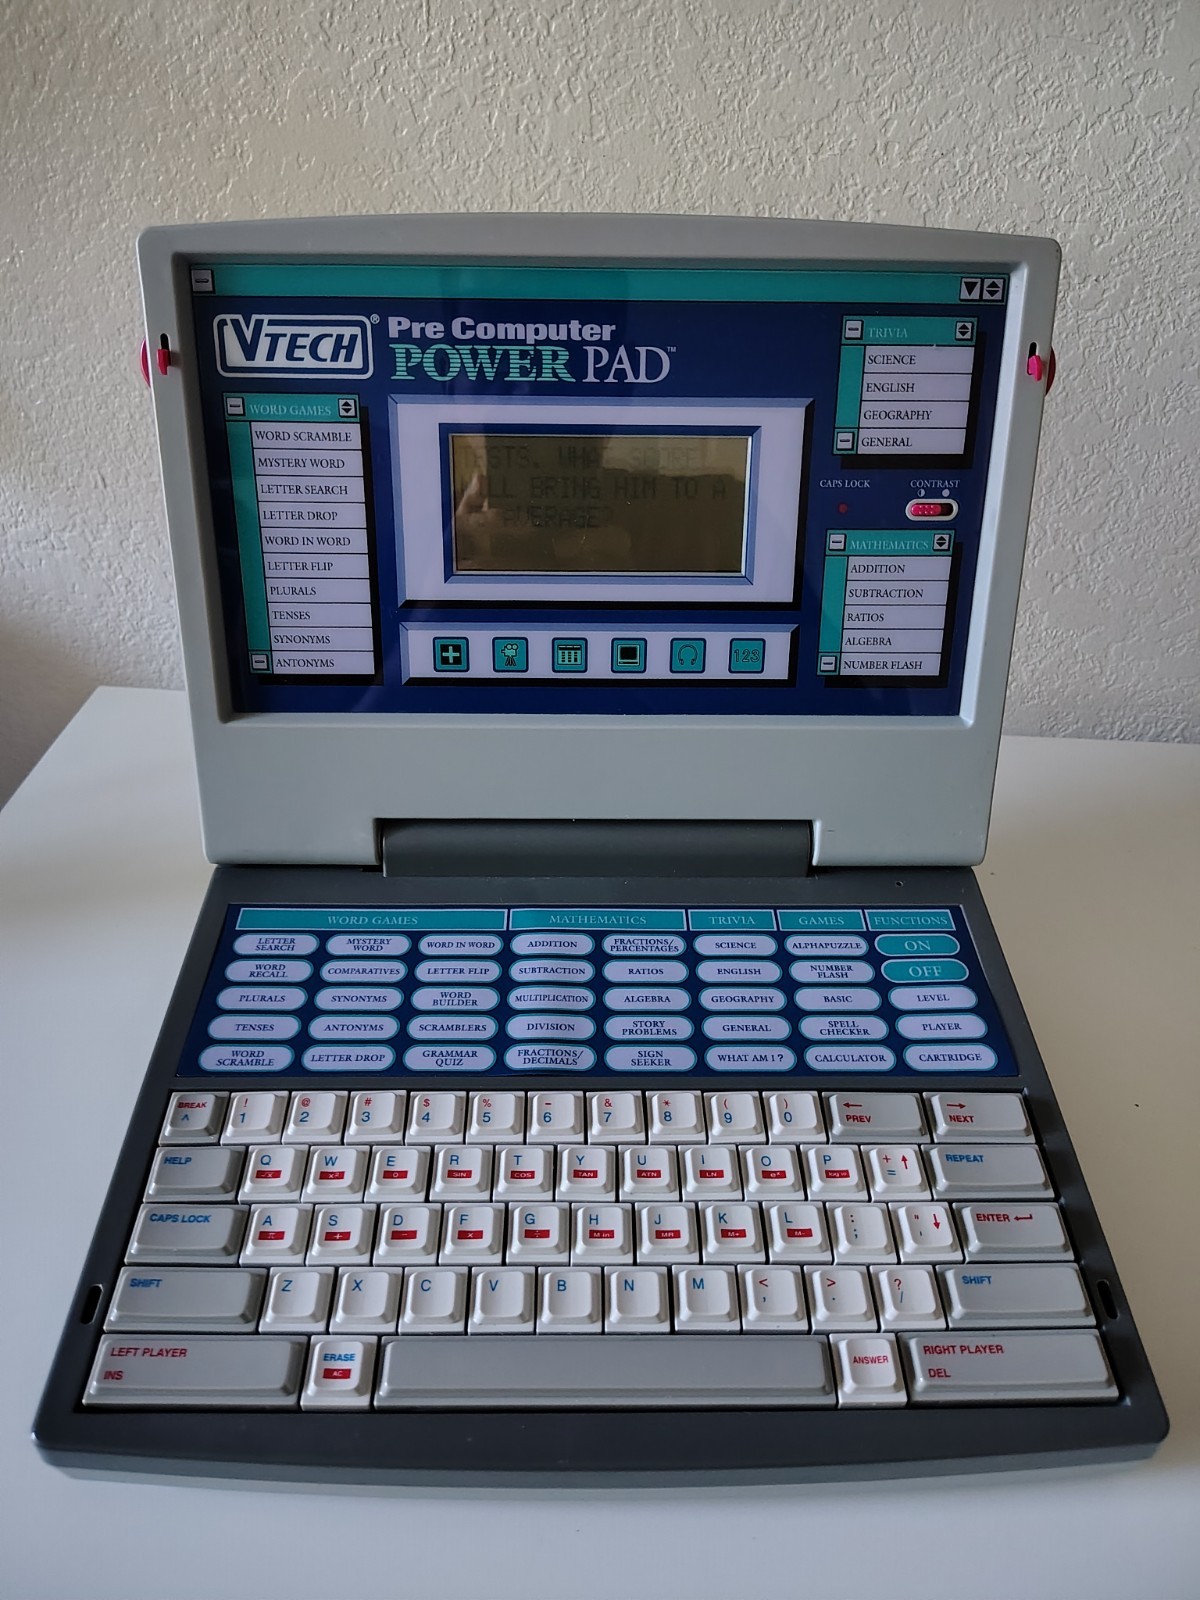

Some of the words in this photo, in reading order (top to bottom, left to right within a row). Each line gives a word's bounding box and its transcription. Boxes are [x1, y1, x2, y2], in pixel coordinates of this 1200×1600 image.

[388, 316, 445, 339] Pre
[451, 317, 616, 344] Computer
[867, 326, 909, 339] TRIVIA
[229, 317, 359, 363] VTECH
[389, 343, 577, 382] POWER
[582, 345, 671, 383] PAD
[866, 353, 918, 366] SCIENCE
[865, 381, 916, 394] ENGLISH
[248, 403, 287, 416] WORD
[290, 404, 332, 417] GAMES
[862, 409, 934, 422] GEOGRAPHY
[254, 429, 291, 442] WORD
[291, 430, 353, 443] SCRAMBLE
[860, 436, 914, 448] GENERAL
[257, 457, 308, 470] MYSTERY
[309, 457, 346, 470] WORD
[260, 483, 303, 496] LETTER
[304, 484, 349, 496] SEARCH
[818, 479, 844, 489] CAPS
[843, 479, 872, 489] LOCK
[909, 479, 961, 489] CONTRAST
[262, 509, 305, 522] LETTER
[305, 509, 338, 522] DROP
[264, 535, 300, 548] WORD
[301, 535, 315, 548] IN
[315, 535, 352, 548] WORD
[849, 539, 930, 551] MATHEMATICS
[266, 560, 309, 573] LETTER
[309, 560, 334, 573] FLIP
[849, 563, 907, 575] ADDITION
[269, 585, 317, 598] PLURALS
[847, 587, 925, 599] SUBTRACTION
[271, 609, 311, 622] TENSES
[846, 612, 886, 623] RATIOS
[273, 633, 332, 646] SYNONYMS
[844, 636, 893, 647] ALGEBRA
[733, 648, 760, 663] 123
[274, 657, 336, 670] ANTONYMS
[842, 660, 889, 671] NUMBER
[889, 660, 924, 671] FLASH
[327, 915, 370, 926] WORD
[371, 915, 419, 926] GAMES
[548, 914, 648, 926] MATHEMATICS
[707, 915, 756, 926] TRIVIA
[798, 915, 845, 926] GAMES
[873, 915, 949, 926] FUNCTIONS
[257, 937, 297, 945] LETTER
[345, 937, 393, 946] MYSTERY
[425, 940, 455, 949] WORD
[455, 940, 467, 949] IN
[467, 940, 496, 950] WORD
[526, 939, 579, 949] ADDITION
[613, 937, 675, 946] FRACTIONS/
[714, 941, 758, 950] SCIENCE
[791, 941, 863, 950] ALPHAPUZZLE
[903, 939, 932, 952] ON
[254, 943, 296, 952] SEARCH
[352, 943, 385, 952] WORD
[609, 944, 680, 954] PERCENTAGES
[254, 963, 287, 971] WORD
[327, 967, 401, 976] COMPARATIVES
[426, 967, 467, 976] LETTER
[467, 967, 491, 976] FLIP
[517, 966, 587, 976] SUBTRACTION
[627, 967, 665, 976] RATIOS
[716, 967, 762, 976] ENGLISH
[809, 964, 854, 973] NUMBER
[907, 965, 943, 978] OFF
[248, 969, 289, 979] RECALL
[816, 971, 850, 979] FLASH
[238, 993, 287, 1003] PLURALS
[330, 994, 388, 1004] SYNONYMS
[439, 991, 473, 1000] WORD
[514, 993, 590, 1004] MULTIPLICATION
[623, 994, 672, 1004] ALGEBRA
[710, 994, 776, 1004] GEOGRAPHY
[823, 994, 853, 1004] BASIC
[916, 993, 951, 1003] LEVEL
[431, 998, 479, 1008] BUILDER
[234, 1023, 275, 1033] TENSES
[323, 1023, 385, 1033] ANTONYMS
[418, 1023, 488, 1033] SCRAMBLERS
[526, 1022, 576, 1033] DIVISION
[631, 1019, 666, 1029] STORY
[721, 1023, 773, 1033] GENERAL
[827, 1019, 860, 1029] SPELL
[921, 1022, 963, 1032] PLAYER
[621, 1027, 678, 1037] PROBLEMS
[819, 1027, 872, 1037] CHECKER
[230, 1049, 266, 1059] WORD
[310, 1053, 353, 1063] LETTER
[353, 1053, 386, 1063] DROP
[421, 1049, 479, 1059] GRAMMAR
[516, 1048, 584, 1059] FRACTIONS/
[636, 1049, 664, 1059] SIGN
[716, 1053, 751, 1063] WHAT
[750, 1053, 770, 1063] AM
[814, 1053, 888, 1063] CALCULATOR
[918, 1052, 983, 1063] CARTRIDGE
[214, 1057, 276, 1068] SCRAMBLE
[434, 1057, 465, 1068] QUIZ
[522, 1056, 579, 1067] DECIMALS
[630, 1057, 672, 1068] SEEKER
[177, 1101, 209, 1110] BREAK
[239, 1112, 246, 1124] 1
[299, 1111, 311, 1123] 2
[360, 1110, 372, 1123] 3
[421, 1111, 432, 1123] 4
[481, 1111, 492, 1124] 5
[542, 1111, 553, 1124] 6
[602, 1111, 613, 1123] 7
[662, 1110, 673, 1123] 8
[723, 1111, 733, 1125] 9
[845, 1113, 872, 1124] PREV
[947, 1114, 975, 1124] NEXT
[163, 1155, 193, 1166] HELP
[259, 1154, 273, 1167] Q
[513, 1154, 523, 1166] T
[822, 1153, 832, 1166] P
[944, 1153, 985, 1164] REPEAT
[149, 1213, 179, 1224] CAPS
[180, 1214, 213, 1224] LOCK
[261, 1214, 274, 1227] A
[523, 1213, 536, 1226] G
[783, 1212, 793, 1225] L
[975, 1212, 1011, 1223] ENTER
[128, 1277, 163, 1289] SHIFT
[487, 1279, 499, 1292] V
[691, 1277, 705, 1291] M
[960, 1274, 993, 1286] SHIFT
[280, 1279, 293, 1293] Z
[109, 1346, 141, 1358] LEFT
[140, 1347, 189, 1359] PLAYER
[922, 1344, 958, 1356] RIGHT
[958, 1343, 1006, 1356] PLAYER
[321, 1352, 357, 1363] ERASE
[851, 1354, 890, 1366] ANSWER
[102, 1369, 124, 1381] INS
[926, 1367, 952, 1380] DEL
